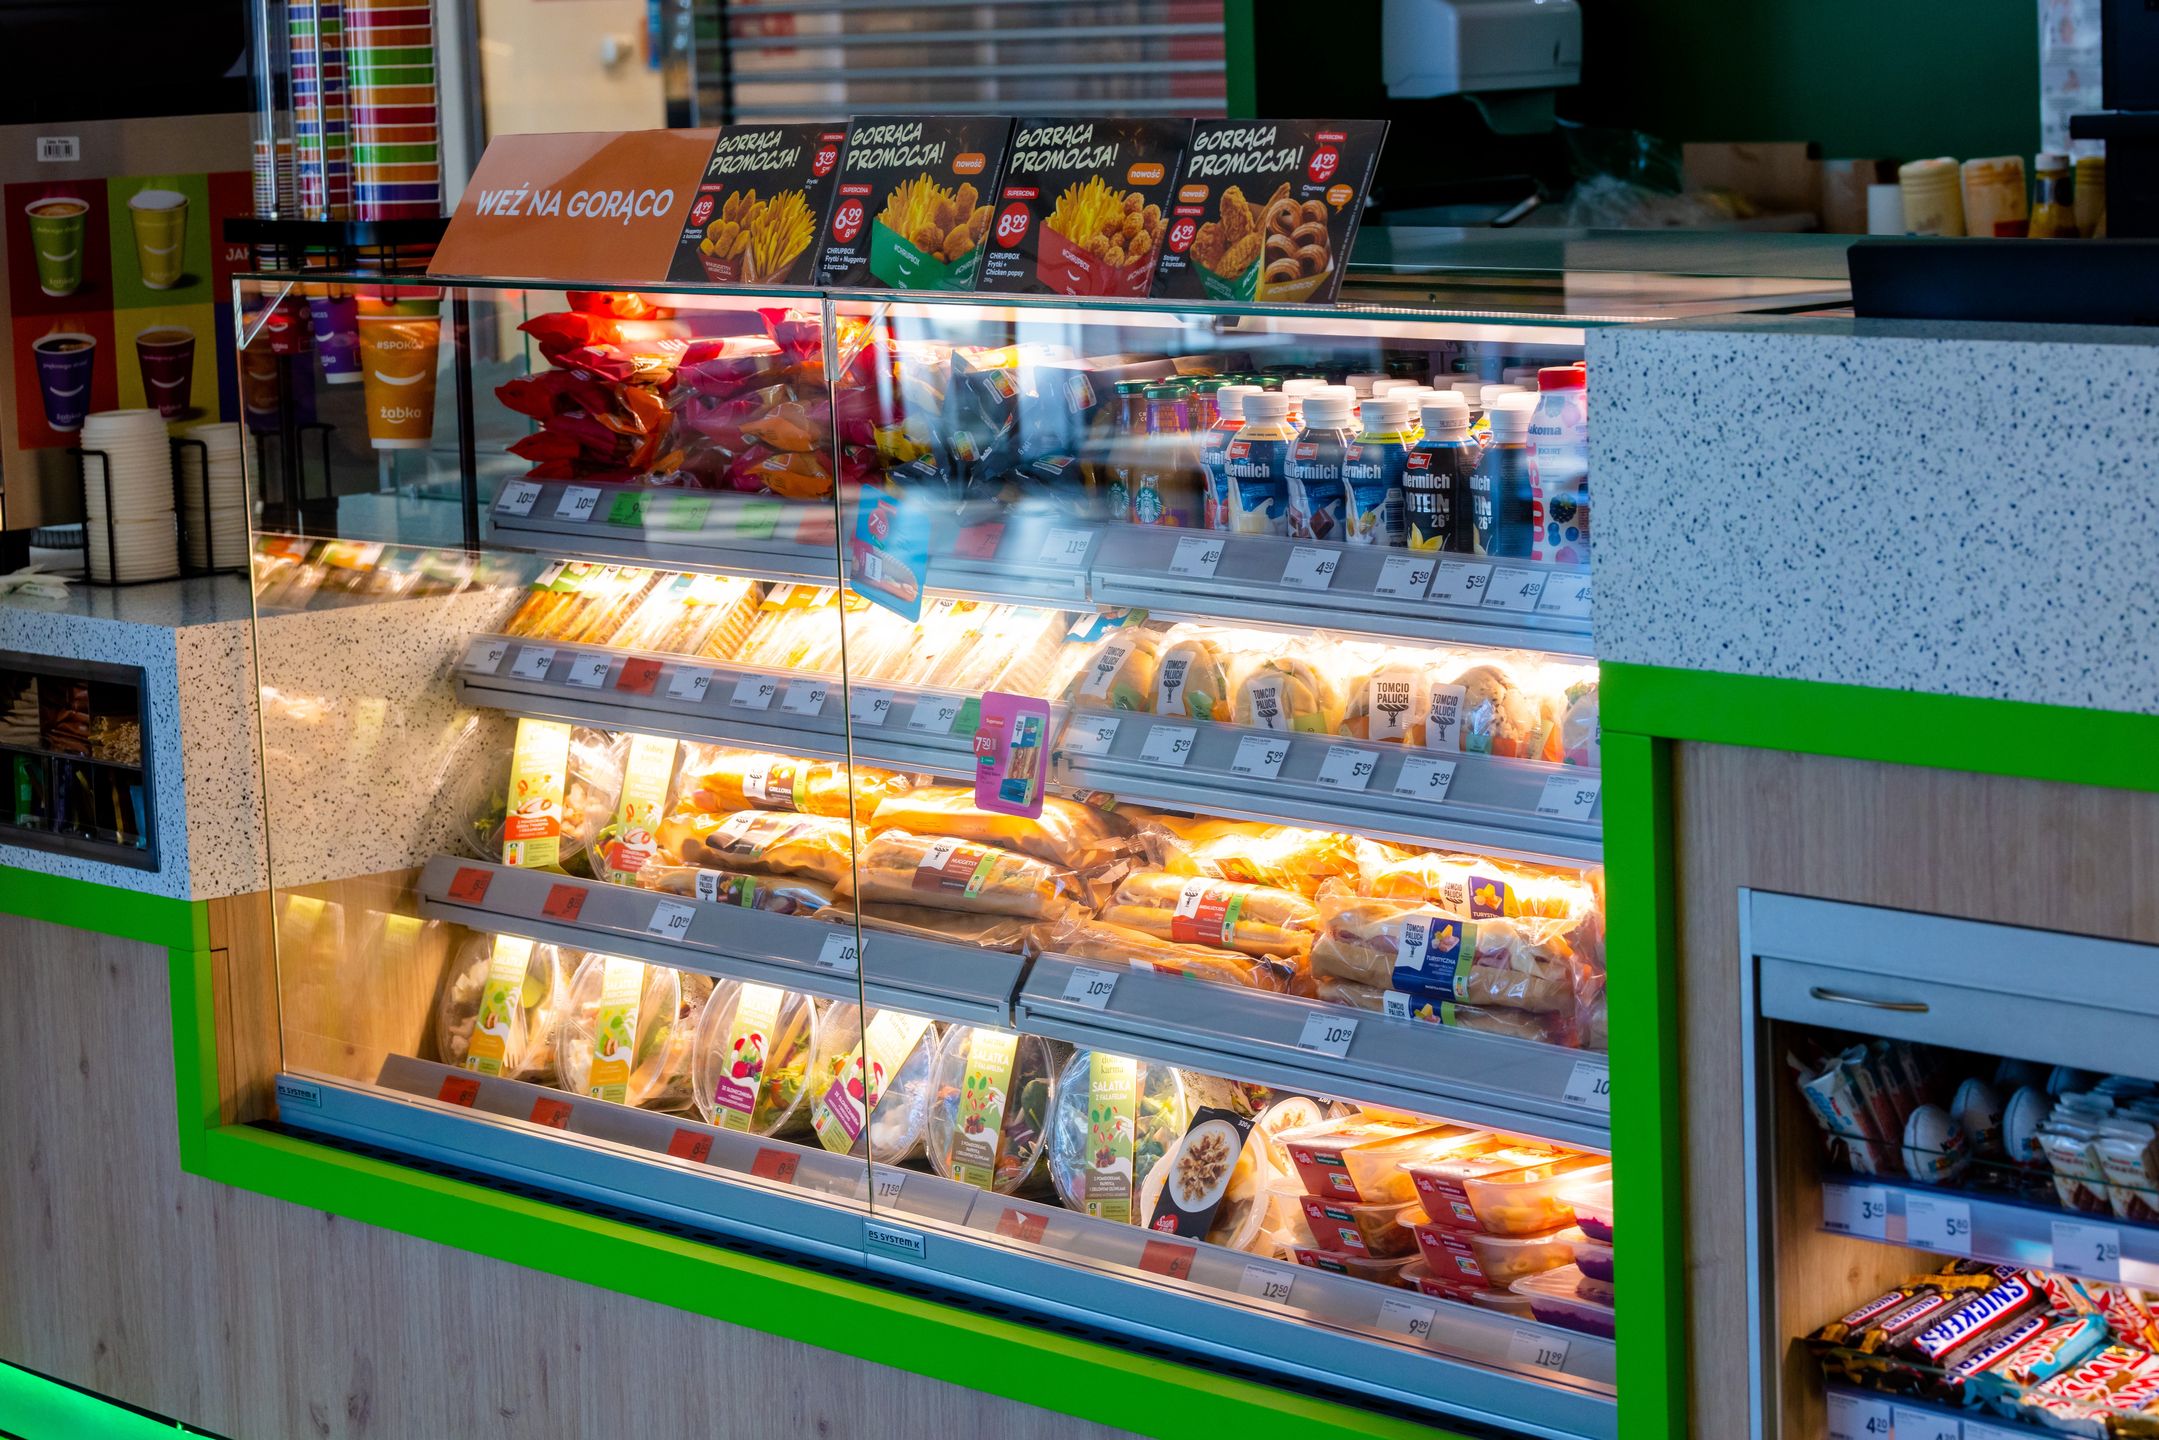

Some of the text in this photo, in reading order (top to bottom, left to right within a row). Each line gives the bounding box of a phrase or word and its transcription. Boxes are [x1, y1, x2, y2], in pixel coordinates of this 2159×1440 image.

[851, 122, 923, 146] GORRĄCA
[1015, 123, 1094, 148] GORRĄCA
[1193, 126, 1277, 152] GORRĄCA
[716, 130, 783, 154] GORRĄCA
[708, 146, 801, 176] PROMOCJA!
[846, 141, 946, 171] PROMOCJA!
[1010, 143, 1120, 174] PROMOCJA!
[1187, 145, 1304, 178] PROMOCJA!
[956, 158, 982, 168] nowość
[1131, 169, 1161, 178] nowość
[476, 182, 674, 225] WEŹ NA GORĄCO
[380, 406, 421, 419] żabka
[1106, 646, 1126, 656] TOMCIO
[1102, 654, 1120, 665] PALUCH
[1166, 660, 1188, 670] TOMCIO
[1164, 670, 1183, 680] PALUCH
[1253, 688, 1276, 698] TOMCIO
[1377, 682, 1410, 693] TOMCIO
[1377, 693, 1409, 703] PALUCH
[1432, 693, 1458, 705] TOMCIO
[1256, 699, 1277, 710] PALUCH
[1431, 705, 1456, 717] PALUCH
[1406, 923, 1424, 933] TOMCIO
[1405, 931, 1423, 941] PALUCH
[1920, 1276, 2024, 1354] SNICKERS
